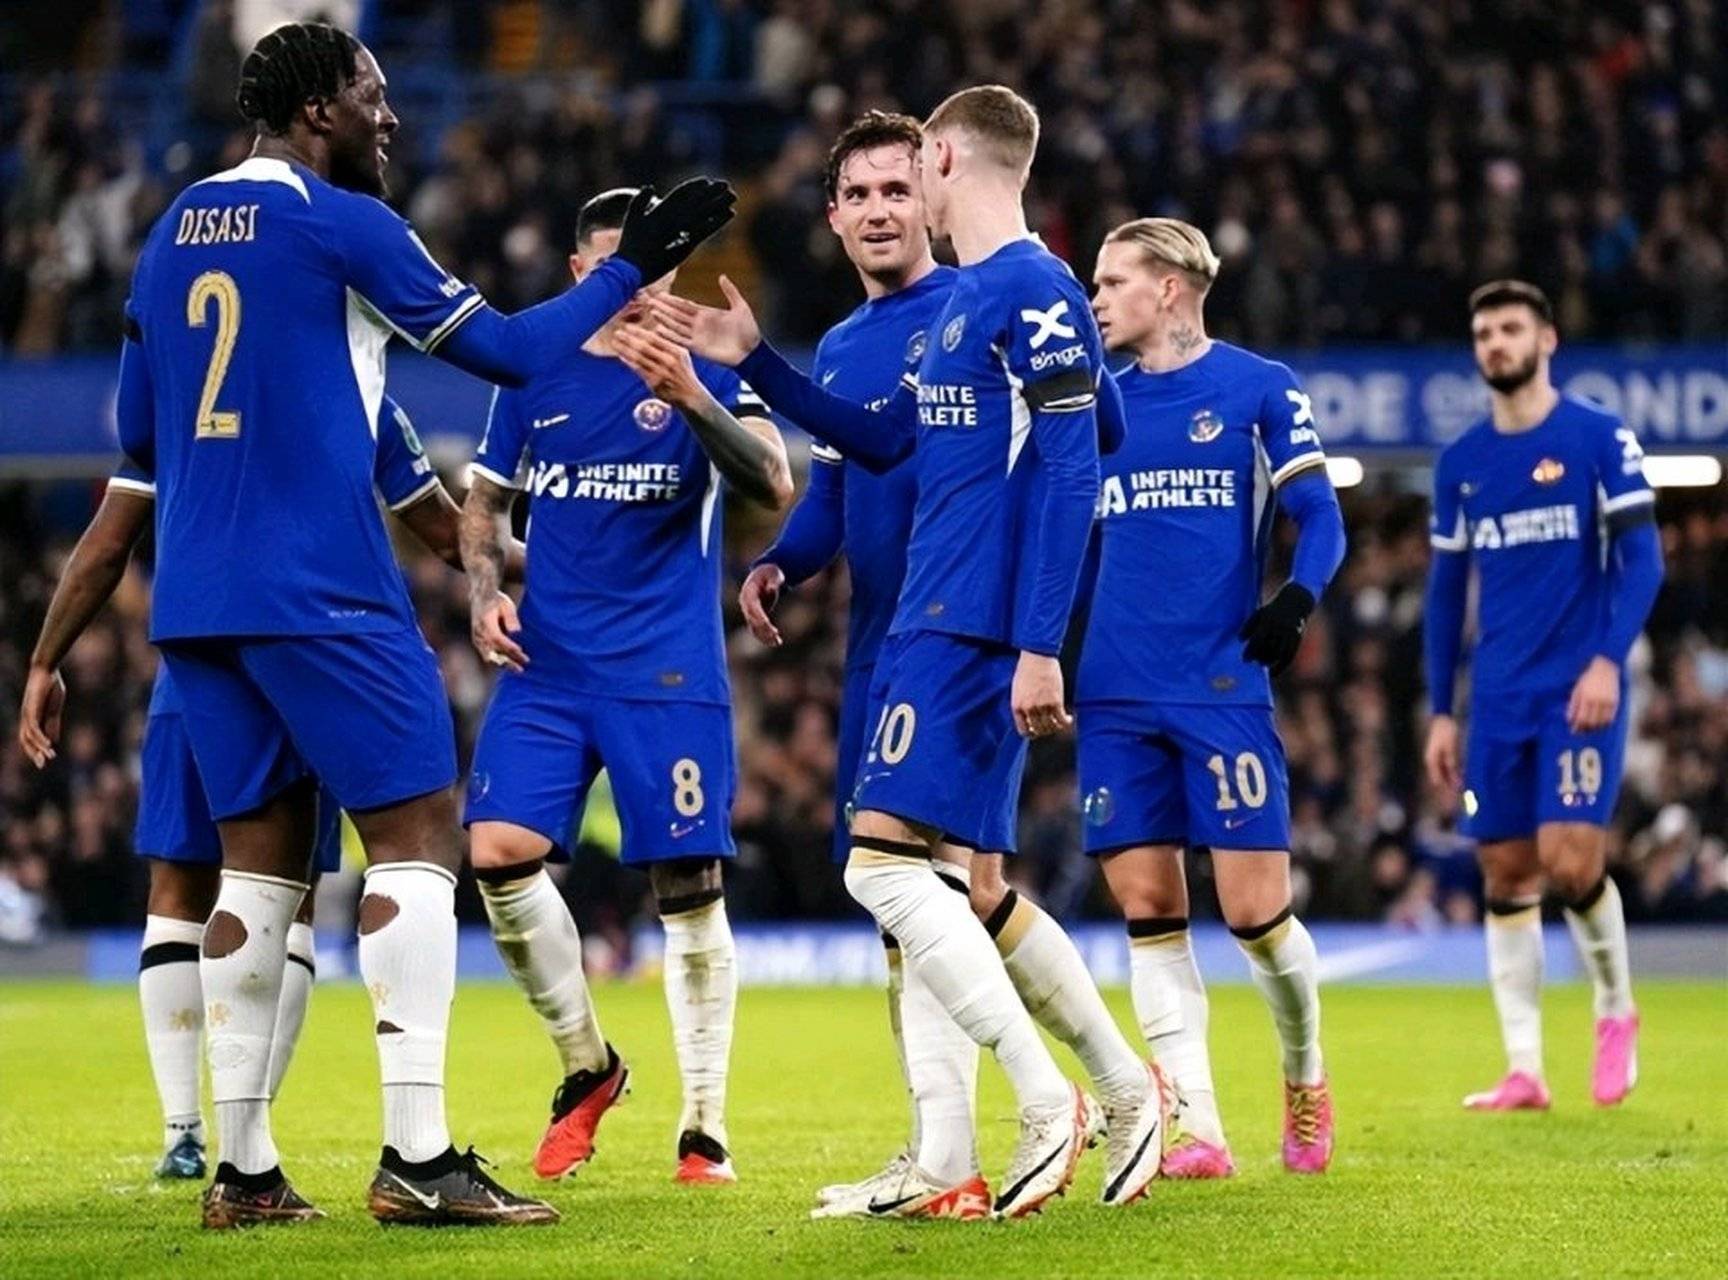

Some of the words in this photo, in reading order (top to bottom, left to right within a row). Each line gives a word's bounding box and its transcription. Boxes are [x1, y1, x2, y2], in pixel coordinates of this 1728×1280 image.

[175, 204, 260, 246] DISASI
[187, 270, 242, 440] 2
[577, 463, 680, 482] INFINITE
[1131, 469, 1235, 490] INFINITE
[573, 480, 680, 501] ATHLETE
[1131, 488, 1235, 510] ATHLETE
[671, 758, 704, 817] 8
[1207, 751, 1268, 811] 10
